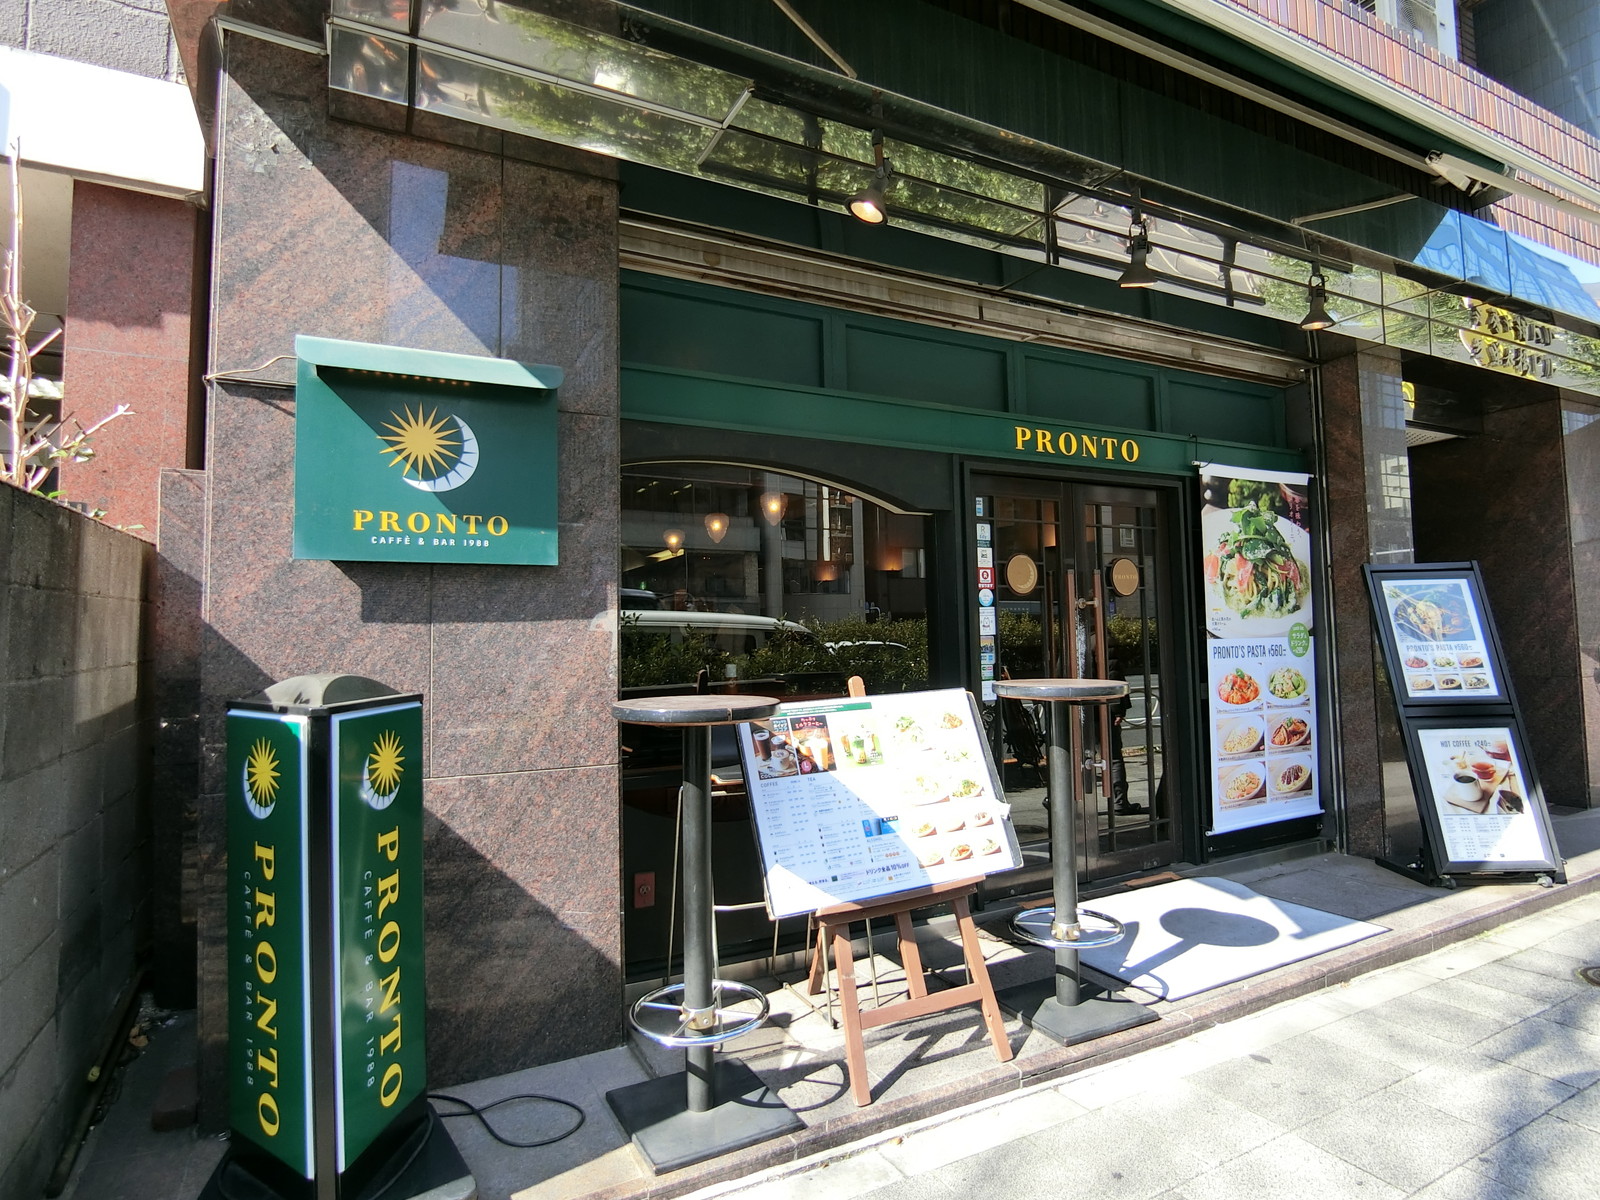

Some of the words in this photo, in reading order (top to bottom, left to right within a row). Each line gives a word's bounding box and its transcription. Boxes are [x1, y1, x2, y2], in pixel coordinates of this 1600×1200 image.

[1015, 426, 1139, 462] PRONTO
[352, 509, 509, 537] PRONTO
[371, 535, 411, 545] CAFFÈ
[418, 537, 425, 545] &
[433, 538, 456, 546] BAR
[463, 539, 490, 547] 1988
[1213, 645, 1245, 659] PRONTO'S
[1247, 645, 1266, 658] PASTA
[245, 954, 253, 964] &
[365, 954, 373, 965] &
[378, 826, 404, 1108] PRONTO
[245, 981, 253, 1022] BAR
[254, 841, 280, 1137] PRONTO
[365, 981, 374, 1022] BAR
[246, 1038, 254, 1086] 1988
[366, 1036, 375, 1088] 1988
